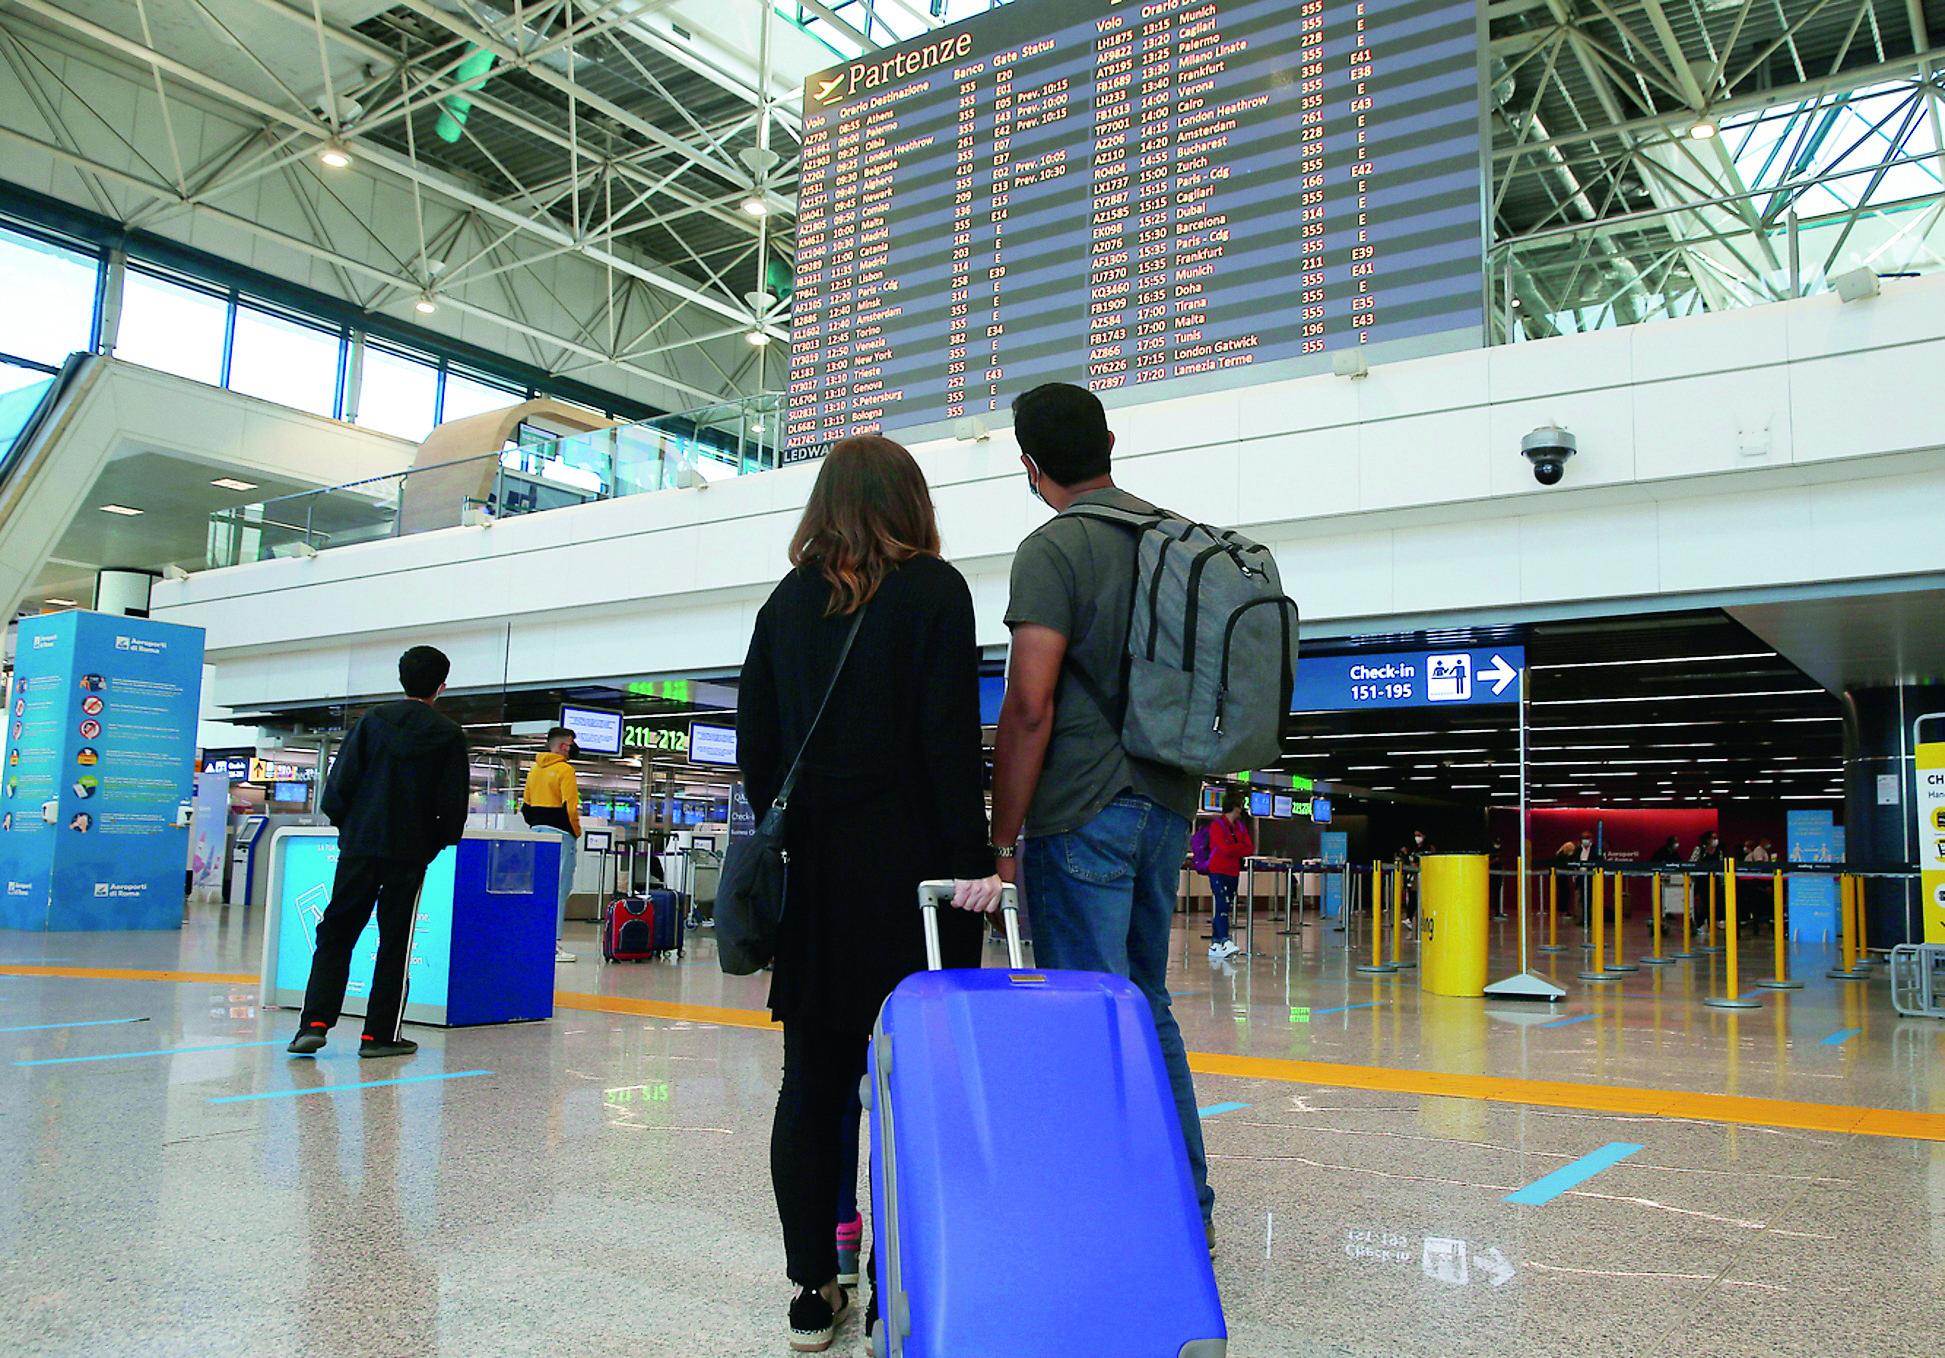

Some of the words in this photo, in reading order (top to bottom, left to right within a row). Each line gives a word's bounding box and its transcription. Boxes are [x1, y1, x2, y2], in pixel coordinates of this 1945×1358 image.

[1096, 59, 1132, 79] AT9195
[1142, 48, 1170, 65] 13:25
[1179, 34, 1220, 54] Palermo
[1302, 0, 1322, 16] 355
[1097, 16, 1122, 32] Volo
[1142, 0, 1179, 18] Orario
[1098, 30, 1133, 50] LH1875
[1143, 18, 1170, 36] 13:15
[1179, 4, 1216, 24] Munich
[1143, 33, 1170, 50] 13:20
[1179, 18, 1215, 39] Cagliari
[848, 32, 973, 95] Partenze
[1096, 90, 1126, 107] LH233
[1142, 77, 1169, 94] 13:40
[1178, 61, 1224, 83] Frankfurt
[1302, 32, 1322, 47] 228
[1142, 62, 1170, 79] 13:30
[1179, 51, 1213, 68] Milano
[1216, 41, 1247, 57] Linate
[1302, 16, 1322, 32] 355
[805, 115, 826, 130] Volo
[840, 101, 869, 118] Orario
[870, 82, 929, 108] Destinazione
[954, 63, 984, 80] Banco
[993, 52, 1018, 67] Gate
[1022, 40, 1055, 57] Status
[1018, 90, 1040, 103] Prev.
[1043, 79, 1068, 95] 10:15
[1095, 118, 1130, 136] TP7001
[1141, 107, 1169, 123] 14:00
[1178, 99, 1203, 112] Cairo
[1302, 63, 1322, 78] 336
[1351, 49, 1371, 64] E41
[1142, 92, 1169, 109] 14:00
[1178, 80, 1214, 97] Verona
[1302, 47, 1322, 62] 355
[865, 149, 893, 164] London
[894, 136, 934, 155] Heathrow
[1017, 104, 1040, 117] Prev.
[1042, 93, 1068, 110] 10:00
[1017, 118, 1039, 131] Prev.
[1042, 107, 1067, 124] 10:15
[1094, 149, 1125, 165] AZ110
[1140, 137, 1168, 153] 14:20
[1177, 120, 1236, 143] Amsterdam
[1302, 94, 1322, 109] 355
[1095, 133, 1125, 151] AZ206
[1141, 121, 1168, 138] 14:15
[1178, 111, 1214, 128] London
[1217, 95, 1269, 117] Heathrow
[1302, 78, 1322, 94] 355
[1351, 65, 1372, 80] E38
[1016, 161, 1038, 173] Prev.
[1040, 150, 1066, 166] 10:05
[1095, 162, 1126, 180] RO404
[1140, 151, 1168, 168] 14:55
[1177, 136, 1227, 158] Bucharest
[1302, 110, 1322, 125] 261
[1351, 98, 1372, 113] E43
[1140, 166, 1168, 183] 15:00
[1177, 156, 1207, 173] Zurich
[1302, 126, 1323, 141] 228
[863, 187, 893, 204] Newark
[956, 163, 973, 175] 410
[994, 152, 1009, 165] E37
[1015, 175, 1037, 187] Prev.
[1040, 165, 1065, 180] 10:30
[1093, 223, 1123, 239] EK098
[1139, 212, 1167, 228] 15:25
[1176, 202, 1205, 219] Dubai
[1302, 174, 1323, 189] 166
[1352, 163, 1372, 177] E42
[1094, 191, 1128, 209] EY2887
[1140, 181, 1167, 198] 15:15
[1177, 173, 1201, 188] Paris
[1210, 166, 1230, 179] Cdg
[1302, 142, 1323, 157] 355
[1140, 197, 1167, 213] 15:15
[1177, 185, 1213, 203] Cagliari
[1302, 158, 1323, 173] 355
[954, 233, 970, 246] 182
[1092, 238, 1123, 254] AZ076
[1139, 227, 1167, 243] 15:30
[1176, 216, 1226, 234] Barcelona
[1302, 191, 1323, 205] 355
[1139, 242, 1166, 259] 15:35
[1176, 235, 1201, 250] Paris
[1210, 229, 1229, 242] Cdg
[1302, 207, 1323, 221] 314
[953, 247, 969, 260] 203
[990, 267, 1005, 279] E39
[1091, 267, 1127, 284] JU7370
[1139, 258, 1166, 274] 15:35
[1176, 246, 1223, 265] Frankfurt
[1302, 223, 1323, 237] 355
[1138, 274, 1166, 289] 15:55
[1175, 263, 1213, 281] Munich
[1302, 239, 1323, 254] 355
[1138, 289, 1165, 304] 16:35
[1175, 283, 1202, 296] Doha
[1302, 257, 1323, 270] 211
[1352, 246, 1373, 260] E39
[856, 308, 902, 325] Amsterdam
[1137, 305, 1166, 320] 17:00
[1174, 299, 1207, 312] Tirana
[1302, 273, 1323, 287] 355
[1352, 263, 1373, 276] E41
[1137, 321, 1166, 336] 17:00
[1175, 314, 1205, 328] Malta
[1302, 289, 1323, 303] 355
[856, 326, 881, 338] Torino
[1089, 359, 1127, 375] VY6226
[1137, 352, 1164, 367] 17:15
[1175, 345, 1212, 360] London
[1215, 335, 1258, 352] Gatwick
[1303, 322, 1323, 336] 196
[1353, 314, 1374, 327] E43
[1137, 336, 1165, 351] 17:05
[1174, 329, 1202, 344] Tunis
[1302, 306, 1323, 320] 355
[1353, 296, 1373, 310] E35
[1089, 375, 1125, 392] EY2897
[1136, 368, 1165, 383] 17:20
[1174, 359, 1216, 376] Lamezia
[1218, 354, 1252, 368] Terme
[1302, 339, 1323, 353] 355
[1349, 663, 1415, 680] Check-in
[1351, 683, 1413, 700] 151-195
[624, 725, 651, 746] 211
[657, 729, 686, 750] 212
[1928, 790, 1945, 799] Han
[110, 883, 147, 891] Aeroporti
